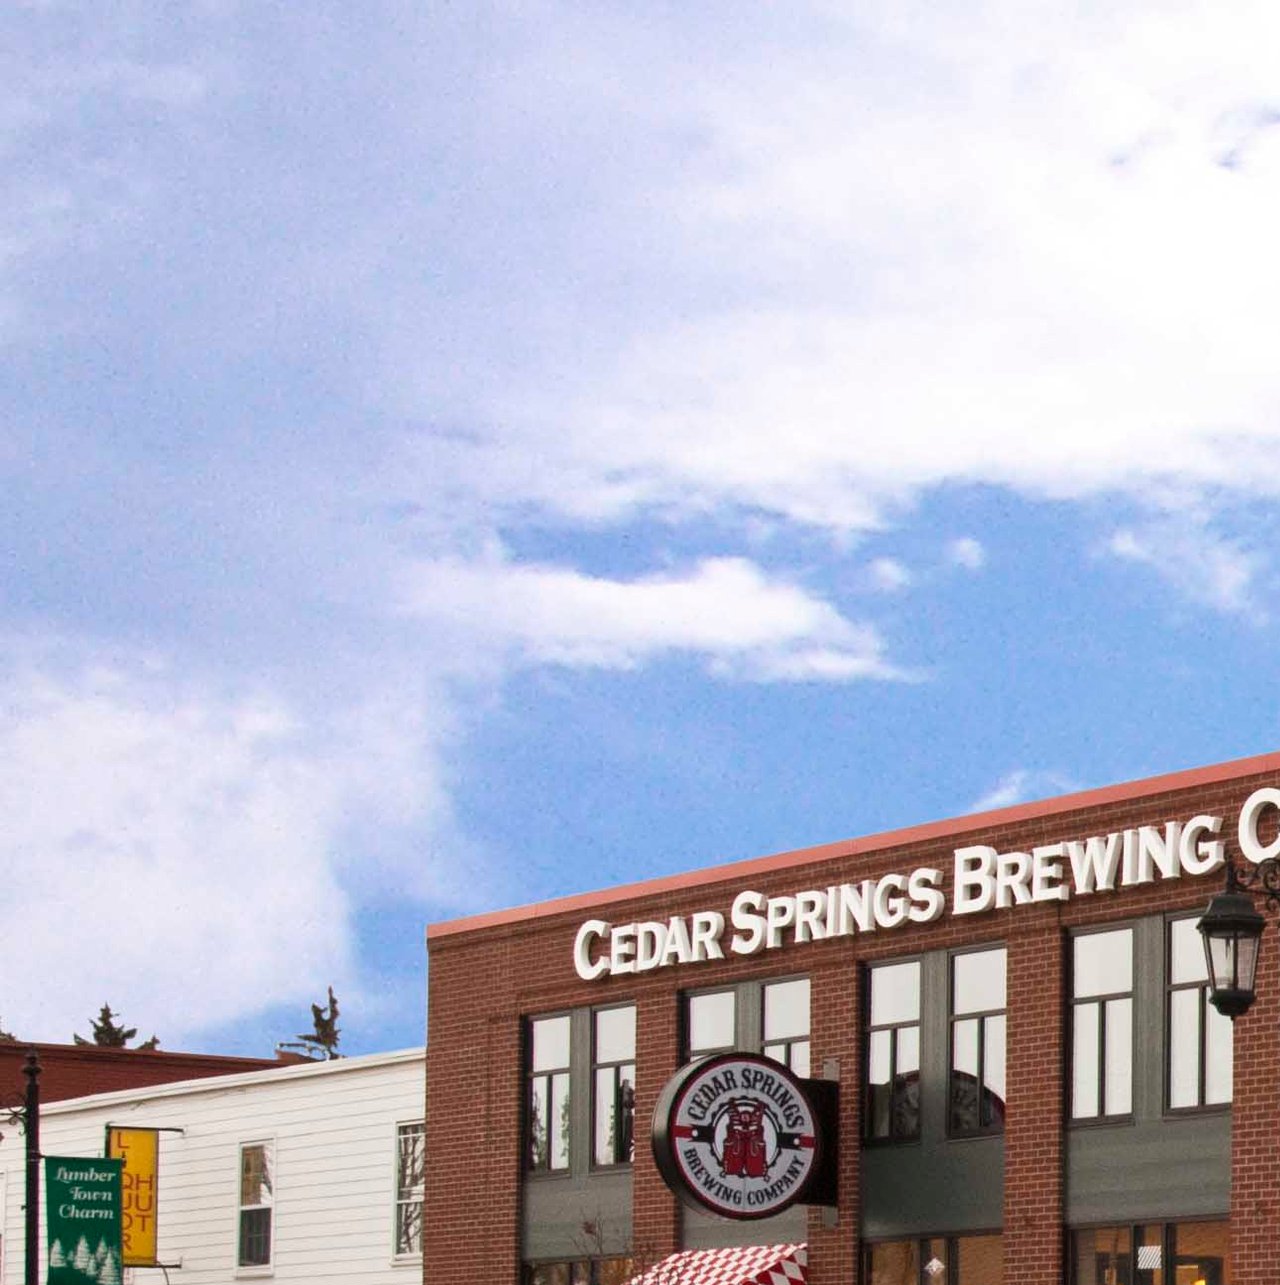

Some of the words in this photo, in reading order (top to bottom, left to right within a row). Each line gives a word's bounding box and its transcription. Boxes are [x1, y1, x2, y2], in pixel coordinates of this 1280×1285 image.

[573, 911, 725, 981] CEDAR
[731, 867, 944, 954] SPRINGS
[952, 814, 1226, 916] BREWING
[687, 1070, 738, 1121] CEDAR
[740, 1067, 805, 1129] SPRINGS
[55, 1166, 116, 1184] Lumber
[69, 1186, 113, 1201] Town
[135, 1173, 153, 1232] HUT
[684, 1146, 742, 1205] BREWING
[747, 1155, 805, 1206] COMPANY
[59, 1203, 114, 1220] Charm
